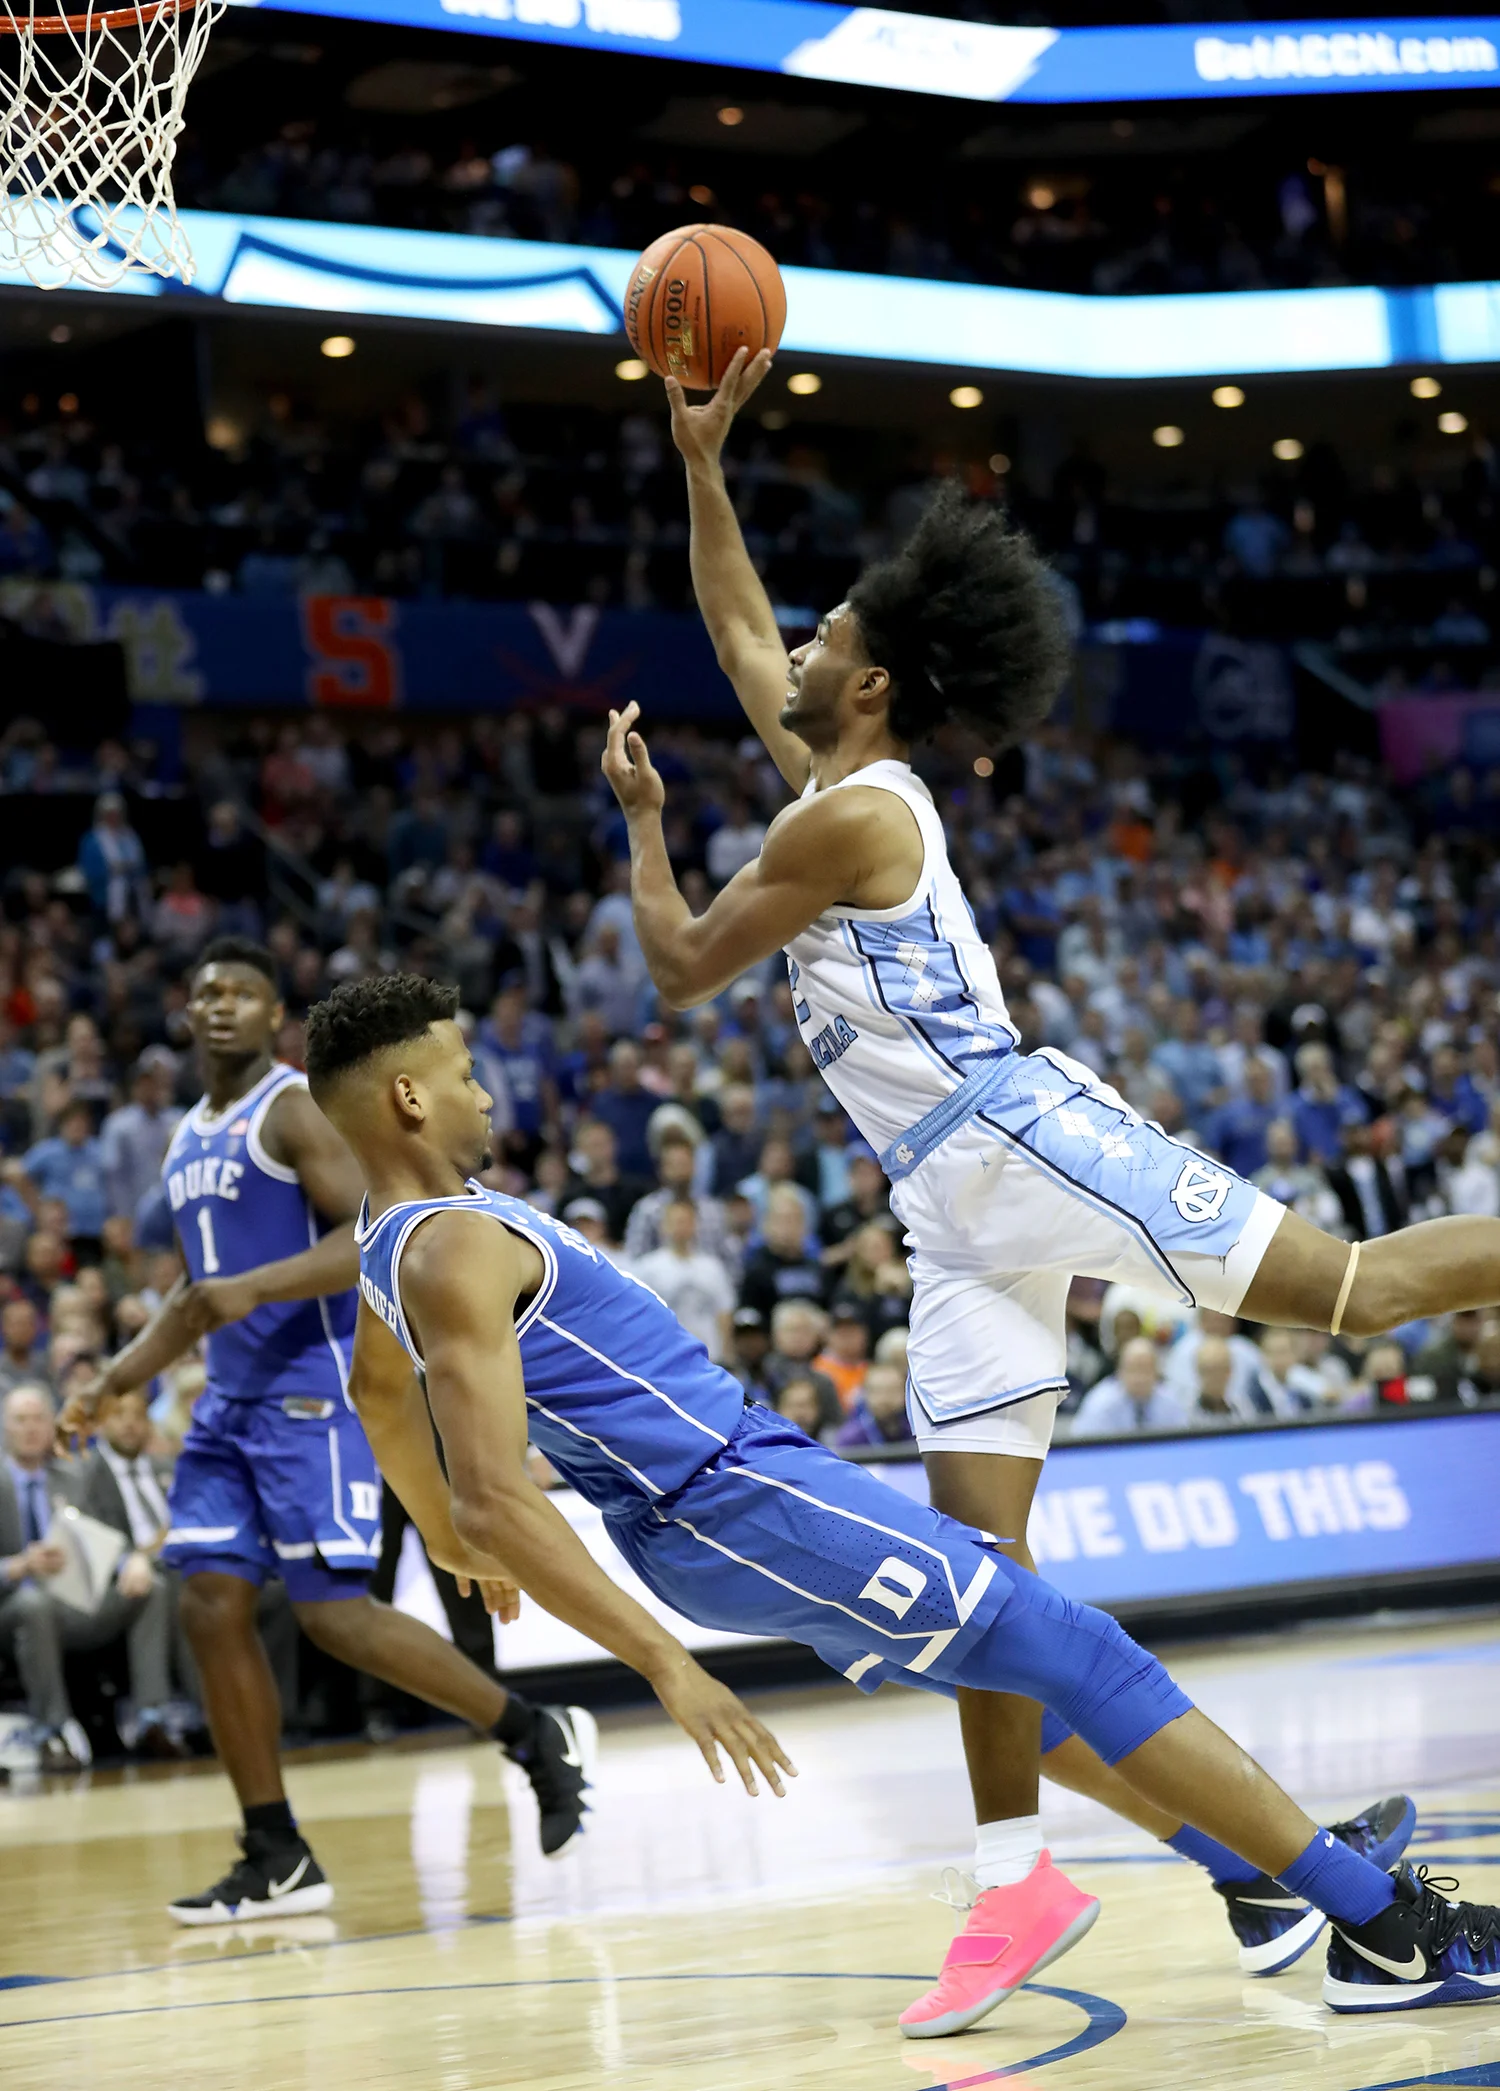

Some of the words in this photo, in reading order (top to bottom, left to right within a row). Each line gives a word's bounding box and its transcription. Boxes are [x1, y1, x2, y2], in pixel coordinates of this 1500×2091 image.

[167, 1156, 246, 1212] DUKE
[197, 1206, 221, 1275] 1
[1125, 1476, 1240, 1554] DO
[1237, 1460, 1412, 1541] THIS
[857, 1556, 928, 1621] D
